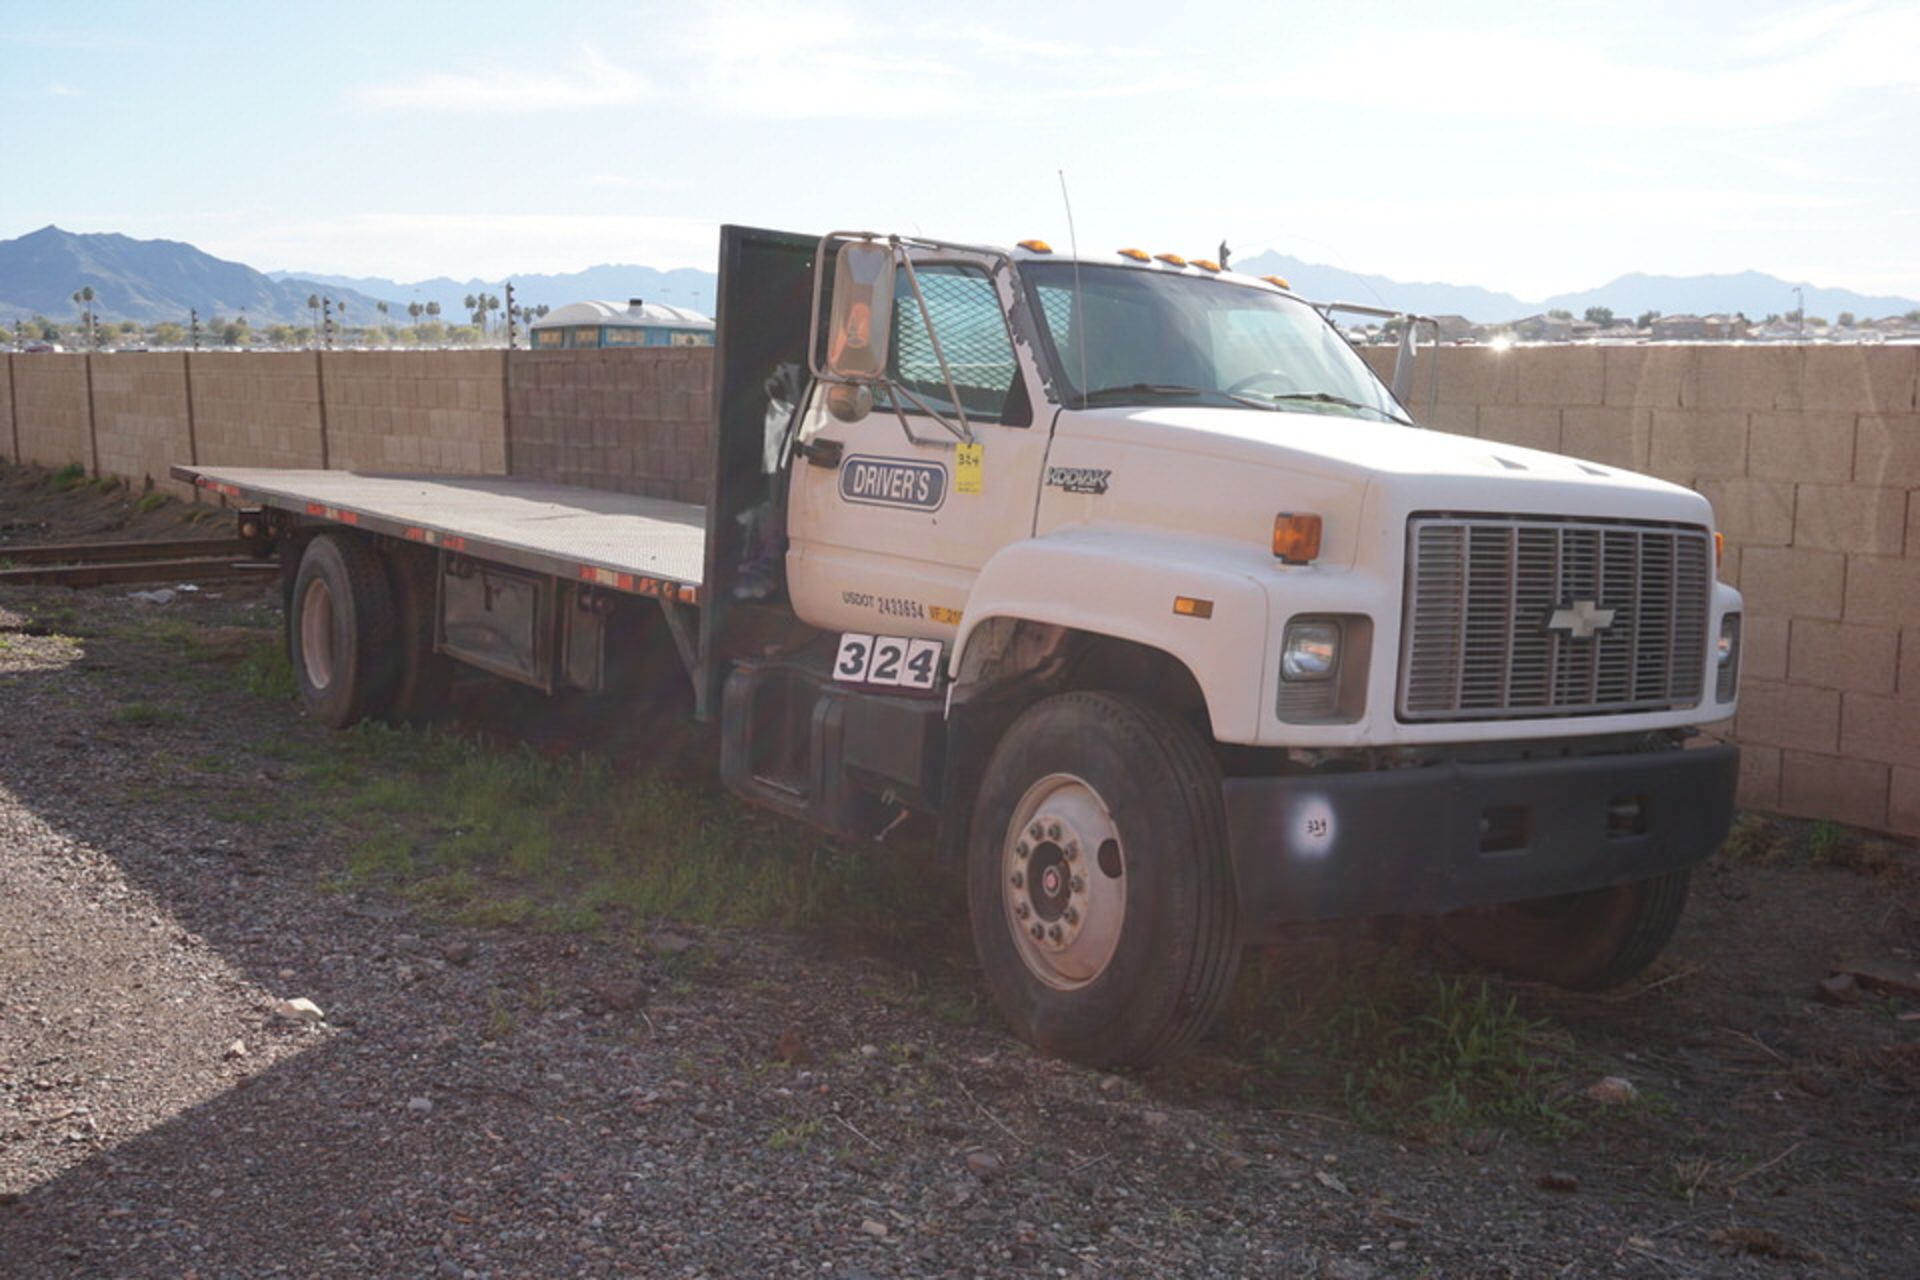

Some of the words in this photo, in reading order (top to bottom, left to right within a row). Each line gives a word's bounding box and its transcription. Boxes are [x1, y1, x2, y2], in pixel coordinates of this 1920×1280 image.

[959, 453, 979, 466] 324
[853, 464, 931, 501] DRIVER'S
[842, 591, 875, 608] USDOT
[839, 642, 934, 683] 324
[1306, 818, 1327, 834] 324
